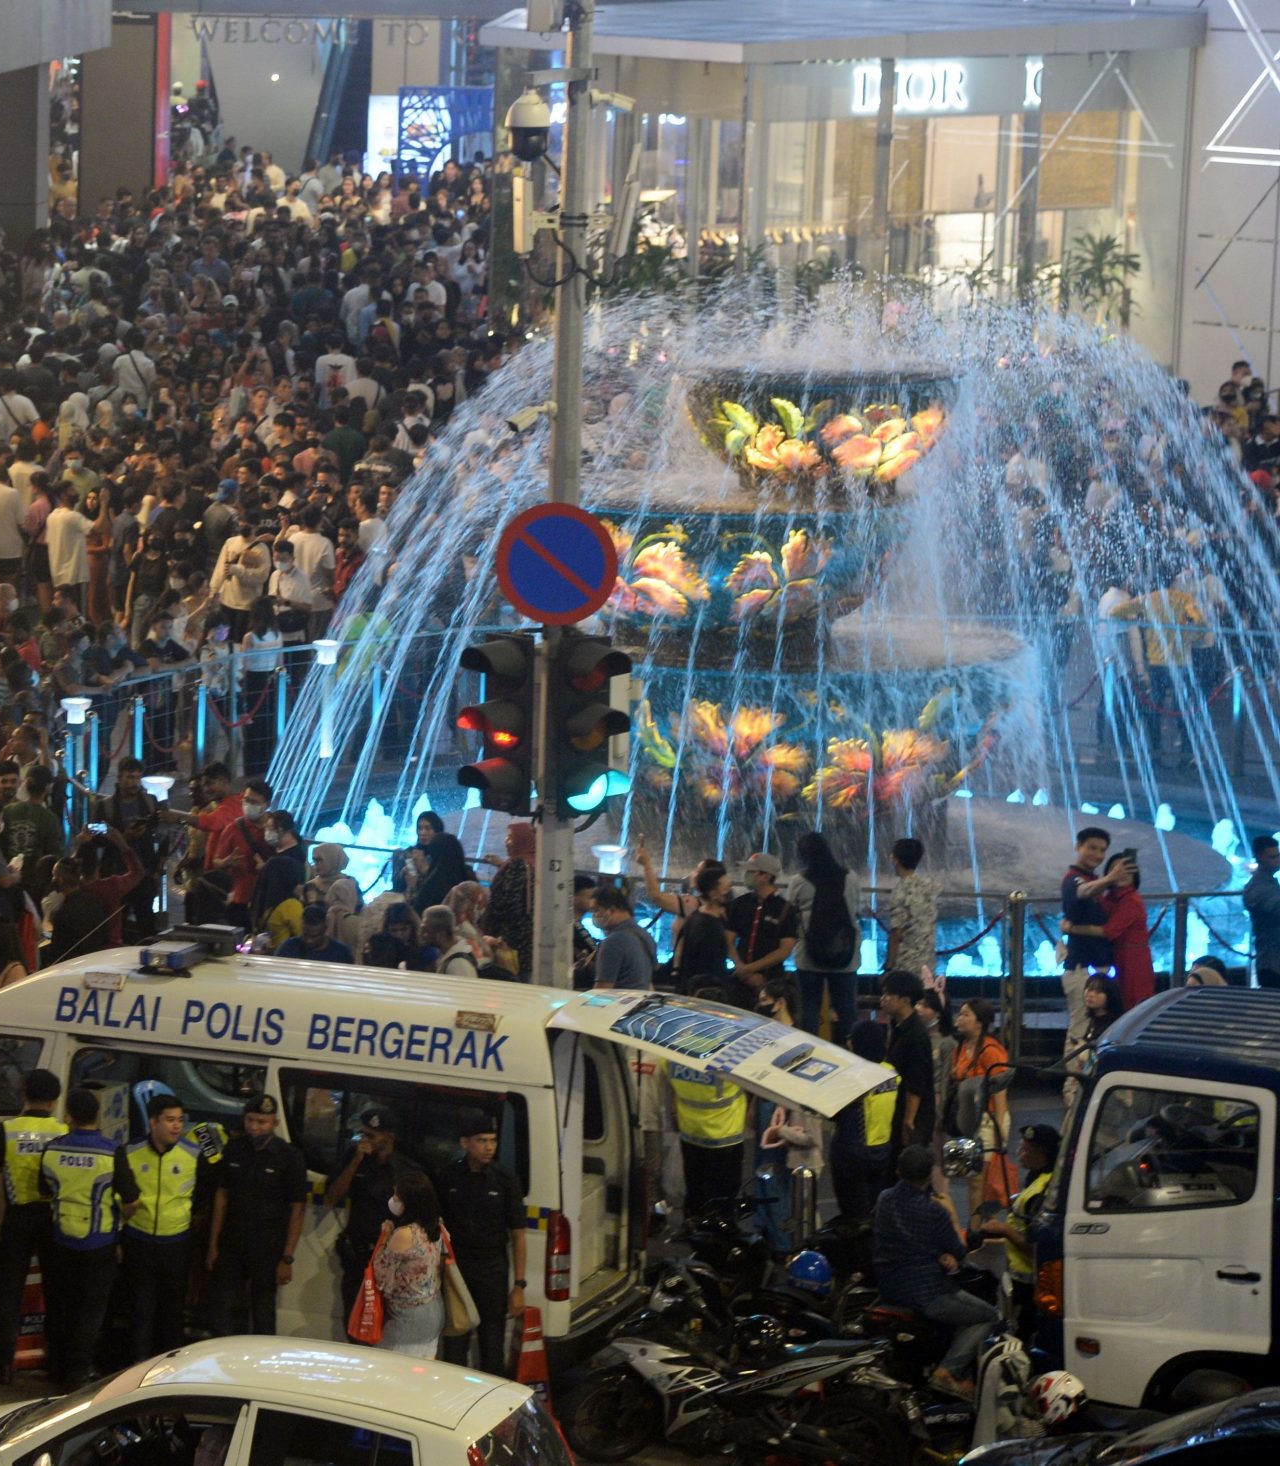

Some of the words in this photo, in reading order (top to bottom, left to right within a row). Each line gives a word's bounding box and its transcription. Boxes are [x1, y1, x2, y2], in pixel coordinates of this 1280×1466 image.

[187, 16, 359, 46] WELCOME
[381, 21, 429, 46] TO
[54, 986, 163, 1032] BALAI
[180, 1000, 286, 1046] POLIS
[306, 1013, 510, 1072] BERGERAK
[195, 1124, 218, 1158] POLIS
[59, 1154, 95, 1168] POLIS
